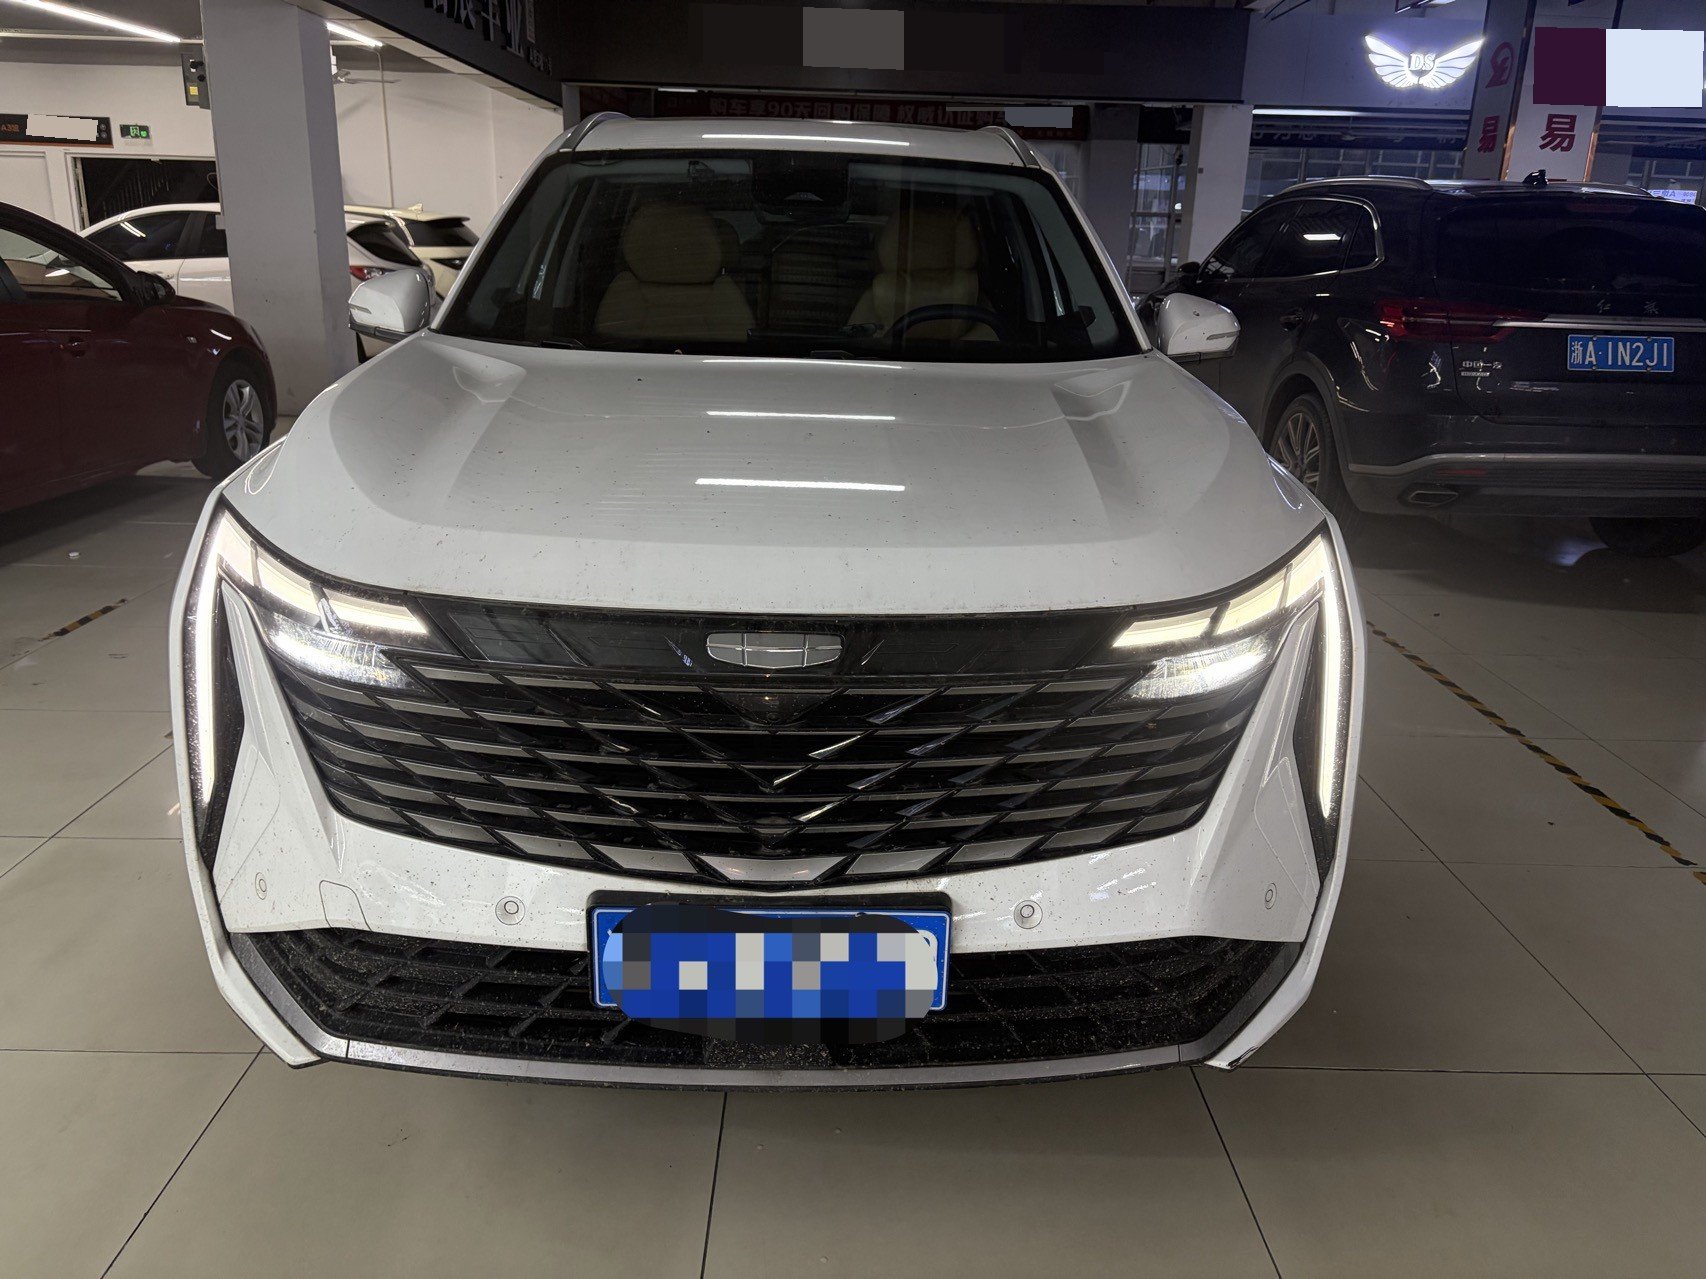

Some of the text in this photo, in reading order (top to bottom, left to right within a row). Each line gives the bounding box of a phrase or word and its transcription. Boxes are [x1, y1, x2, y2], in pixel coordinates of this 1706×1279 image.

[1409, 52, 1436, 71] DS
[1478, 115, 1500, 153] 易
[1538, 113, 1577, 152] 易
